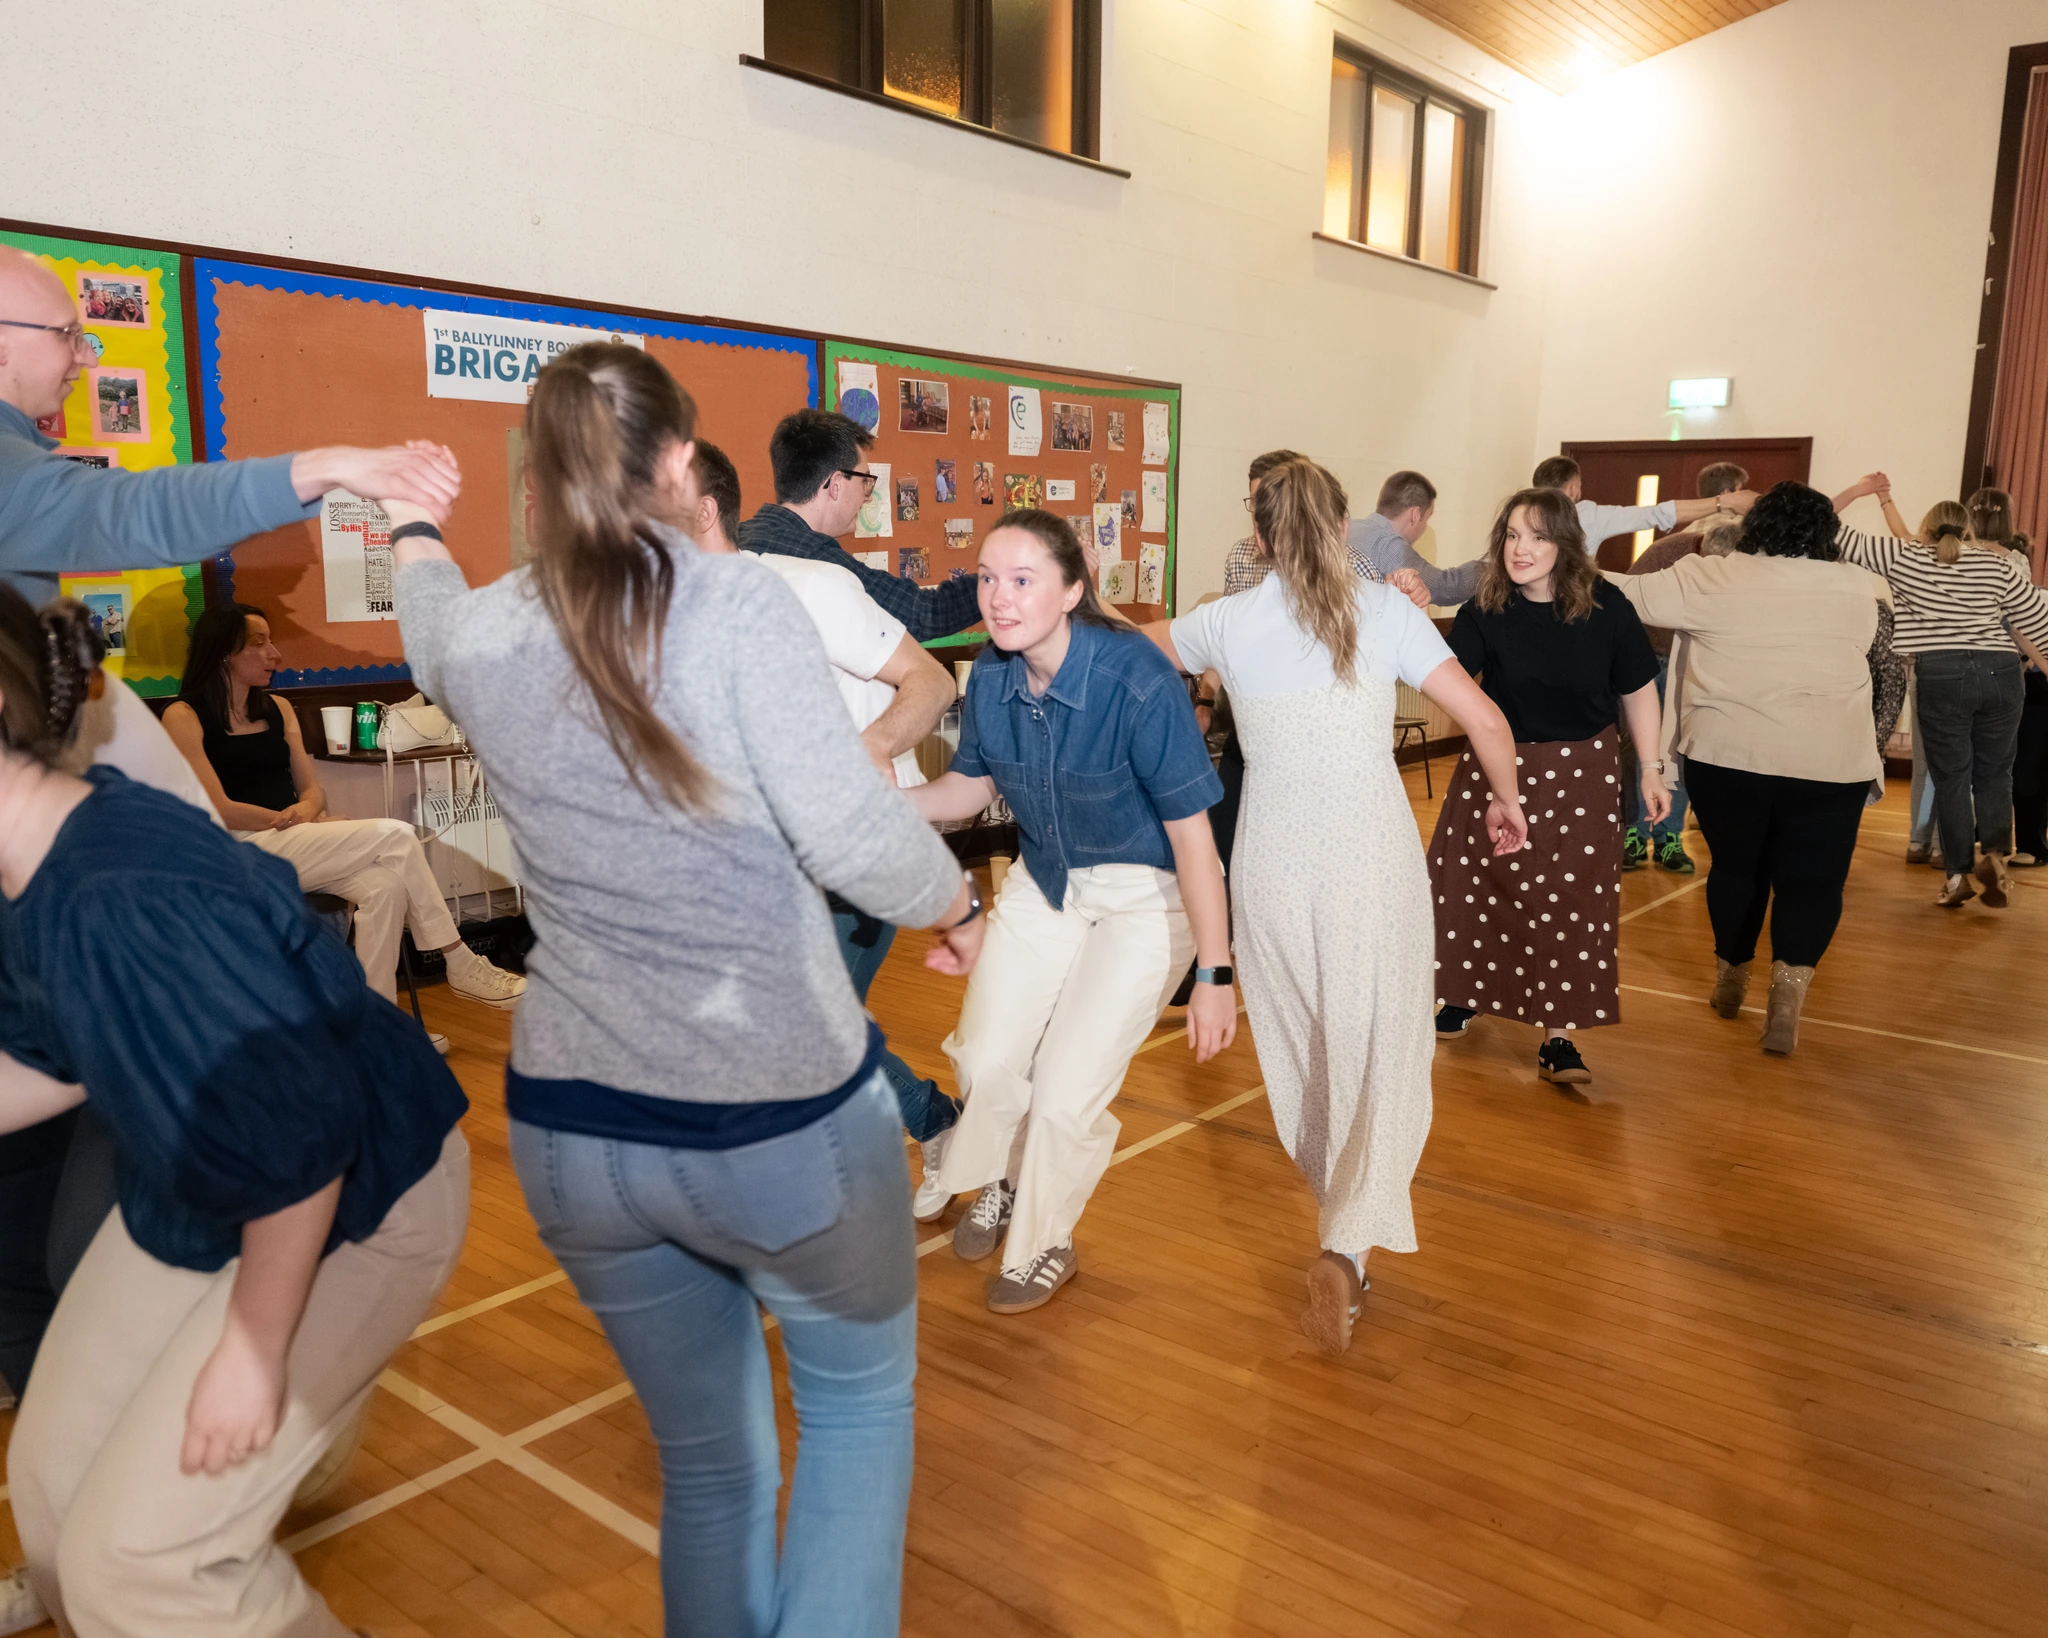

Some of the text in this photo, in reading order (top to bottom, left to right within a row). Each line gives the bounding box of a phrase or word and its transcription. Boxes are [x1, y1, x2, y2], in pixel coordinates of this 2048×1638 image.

[433, 328, 448, 340] 1st
[452, 330, 543, 351] BALLYLINNEY
[435, 344, 557, 383] BRIGA
[329, 508, 341, 532] LOSS
[341, 524, 362, 533] By His
[368, 558, 383, 567] HATE
[371, 580, 387, 589] lust
[371, 601, 393, 612] FEAR
